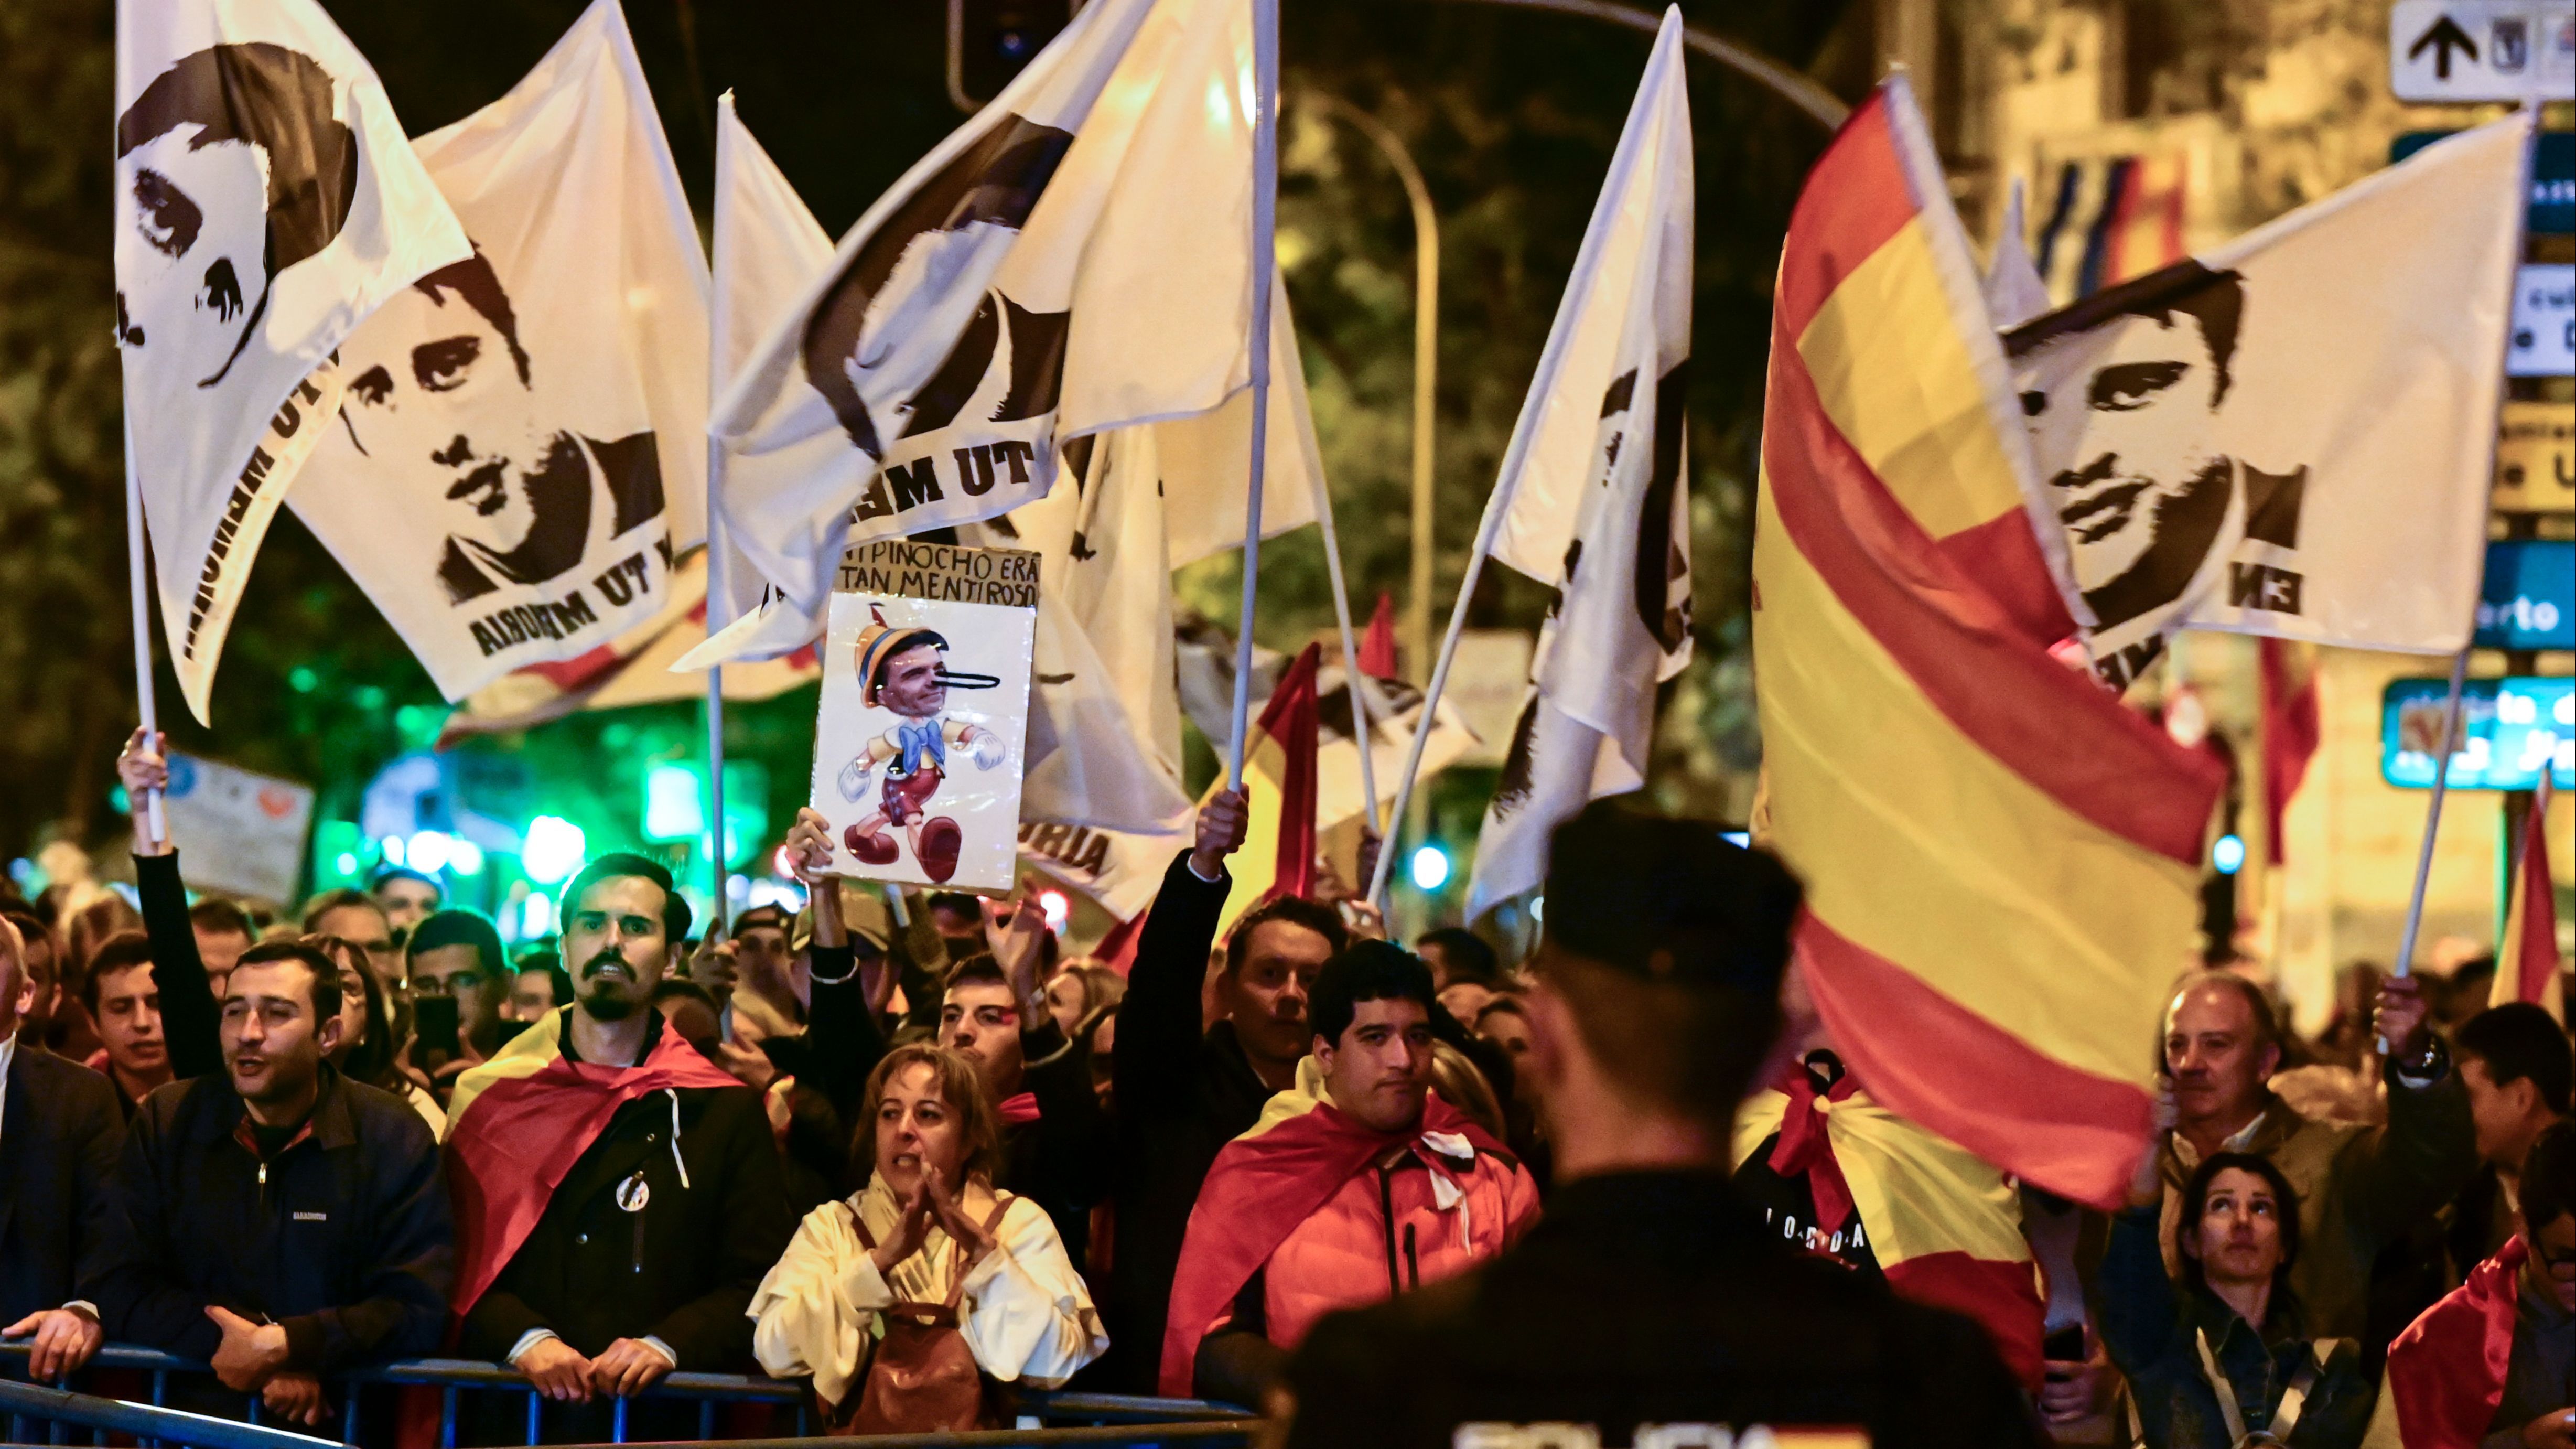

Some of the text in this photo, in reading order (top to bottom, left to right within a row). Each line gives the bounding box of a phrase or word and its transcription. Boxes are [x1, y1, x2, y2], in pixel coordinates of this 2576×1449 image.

[871, 541, 992, 579] PINOCHO
[1000, 556, 1038, 583] ERA
[840, 566, 1036, 607] TAN MENTIROSO
